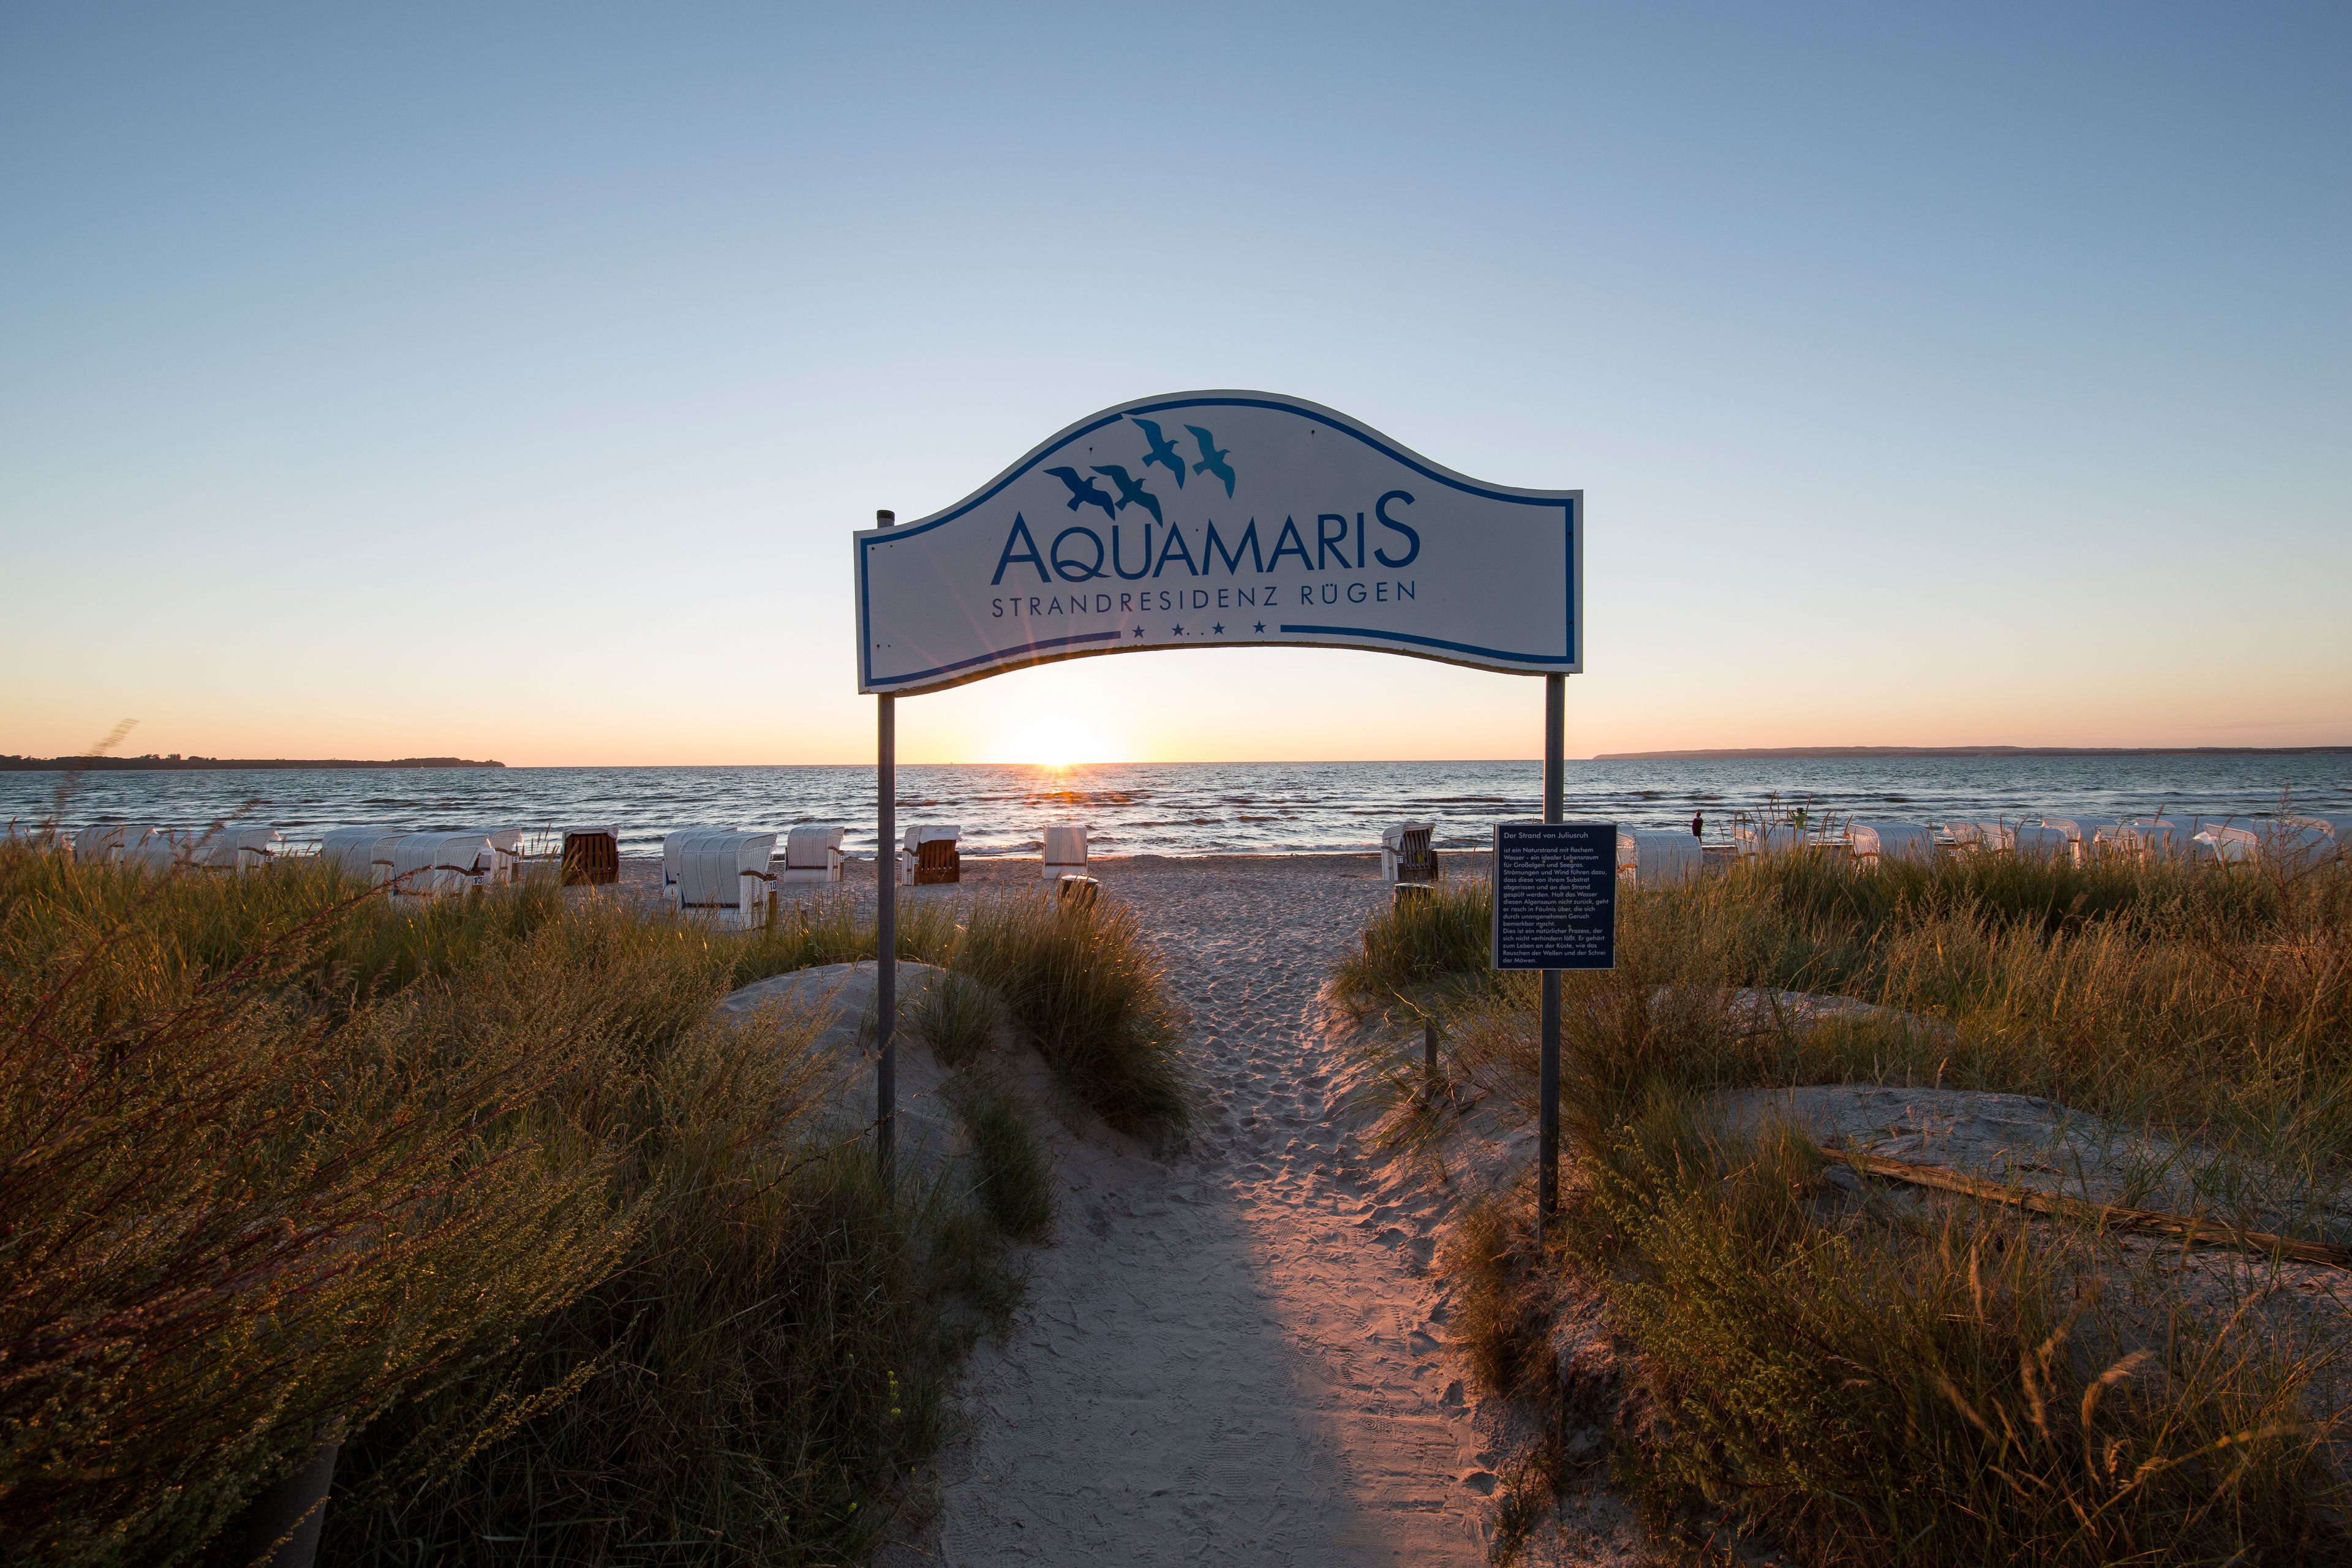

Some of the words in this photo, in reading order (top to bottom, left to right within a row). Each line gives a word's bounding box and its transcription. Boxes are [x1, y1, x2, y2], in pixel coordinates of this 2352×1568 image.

[990, 490, 1420, 586] AQUAMARIS
[992, 586, 1278, 618] STRANDRESIDENZ
[1300, 581, 1416, 605] RÜGEN
[473, 876, 483, 884] 13
[769, 881, 777, 891] 10
